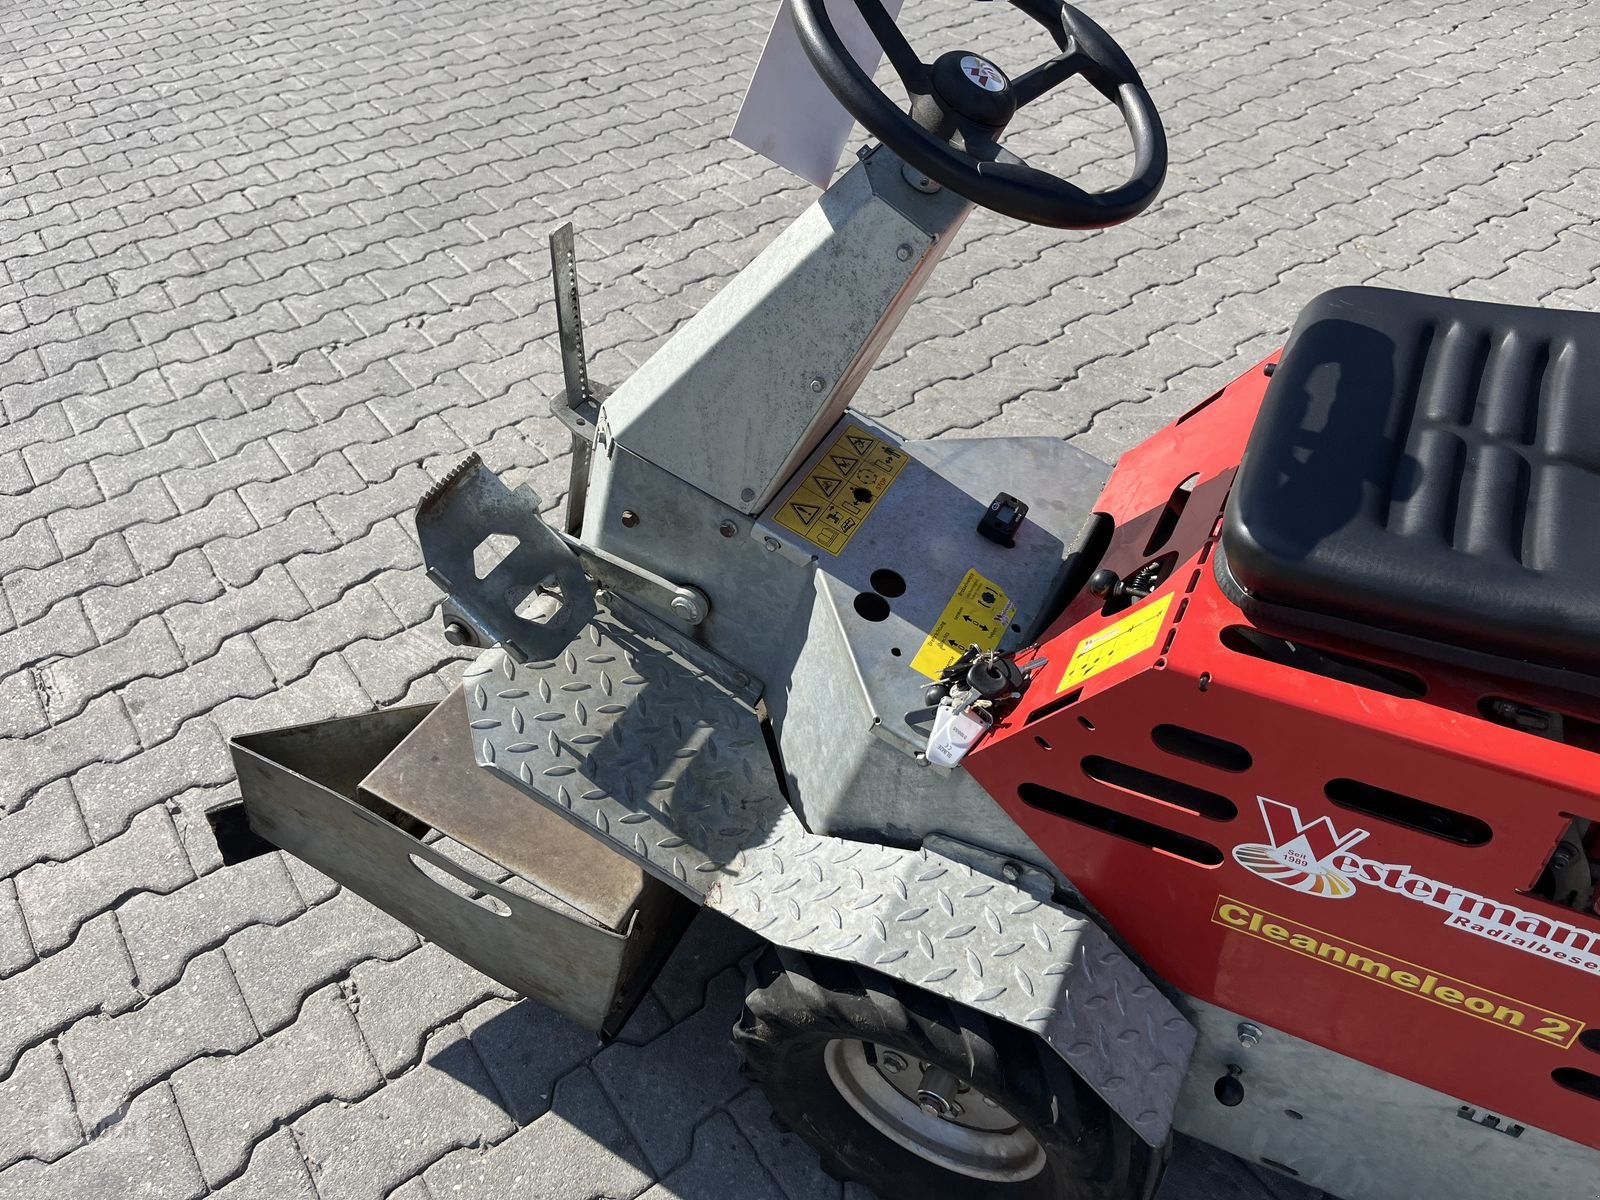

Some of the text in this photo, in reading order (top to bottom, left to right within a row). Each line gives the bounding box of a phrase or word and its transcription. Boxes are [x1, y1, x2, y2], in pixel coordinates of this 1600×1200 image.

[875, 477, 887, 490] STOP
[1282, 854, 1309, 868] 1989
[1287, 849, 1307, 860] Seit
[1452, 915, 1600, 973] Radialbese
[1218, 903, 1572, 1042] Cleanmeleon 2
